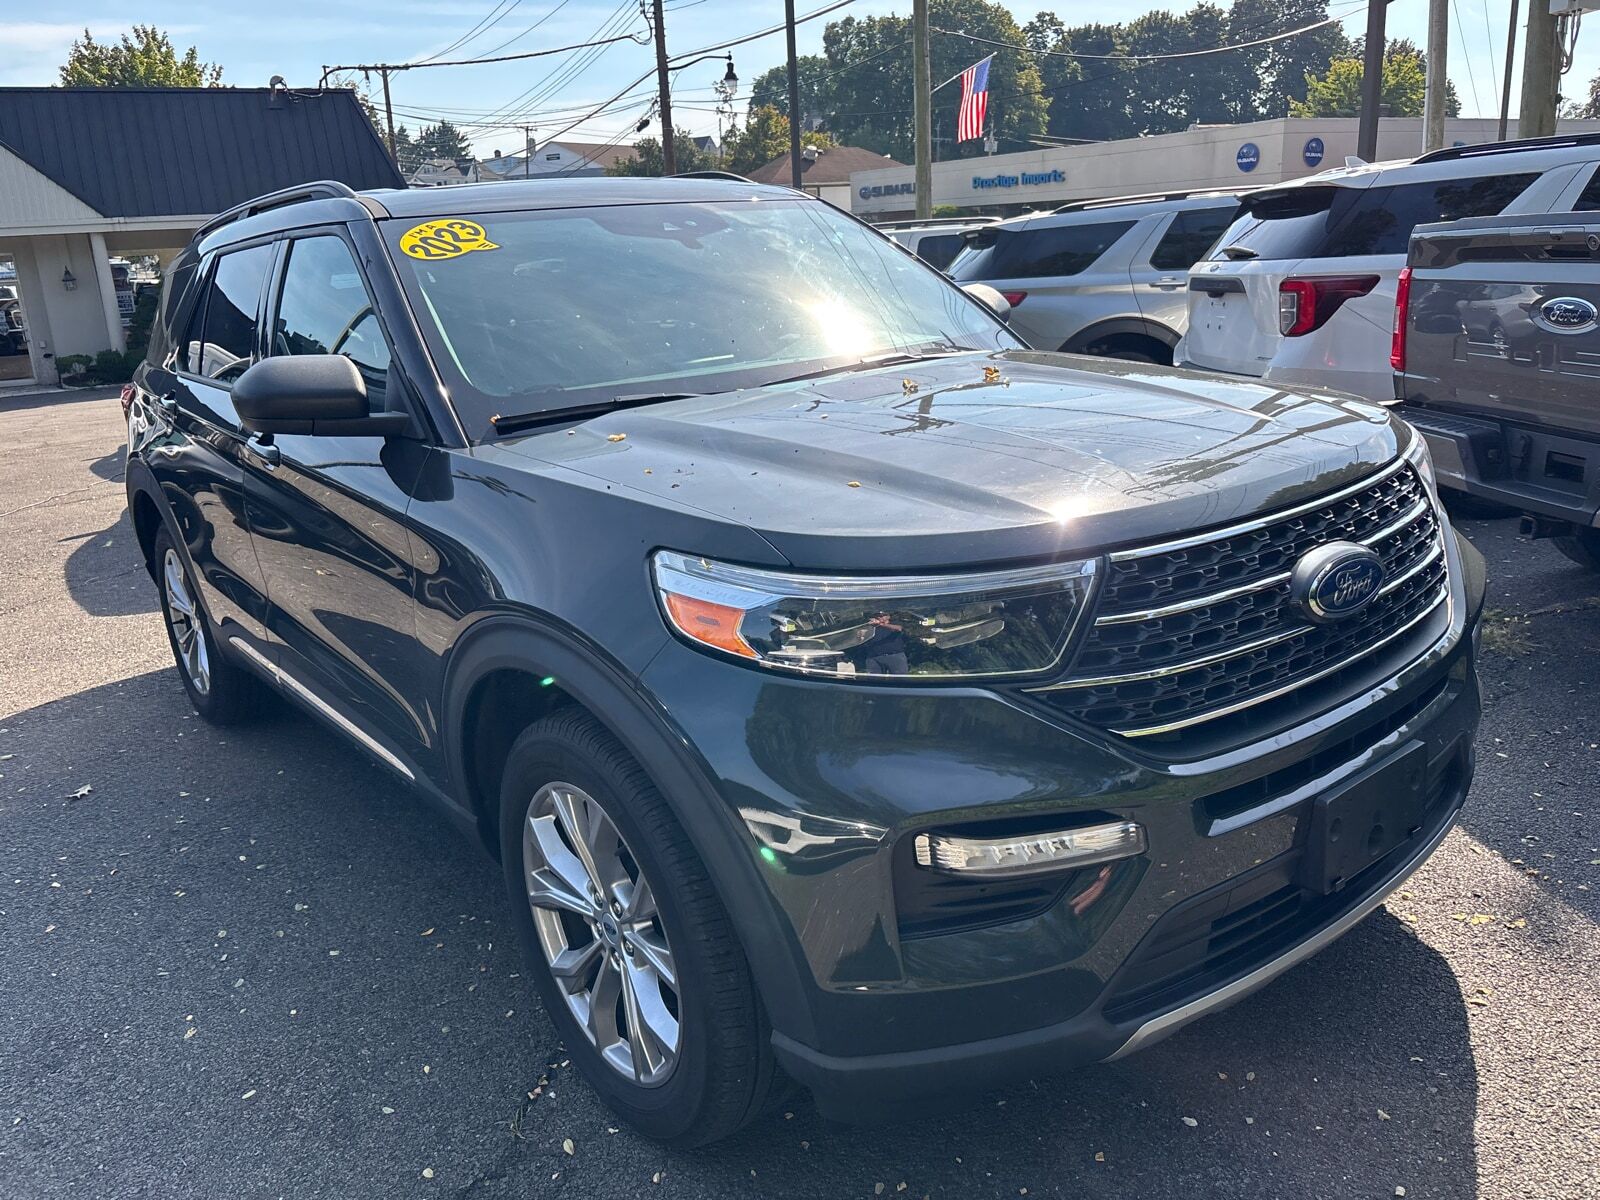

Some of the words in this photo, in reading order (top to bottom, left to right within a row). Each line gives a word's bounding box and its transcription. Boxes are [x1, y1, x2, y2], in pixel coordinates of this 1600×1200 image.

[409, 221, 481, 258] 2023
[1550, 303, 1582, 322] Ford
[1333, 563, 1374, 606] Ford
